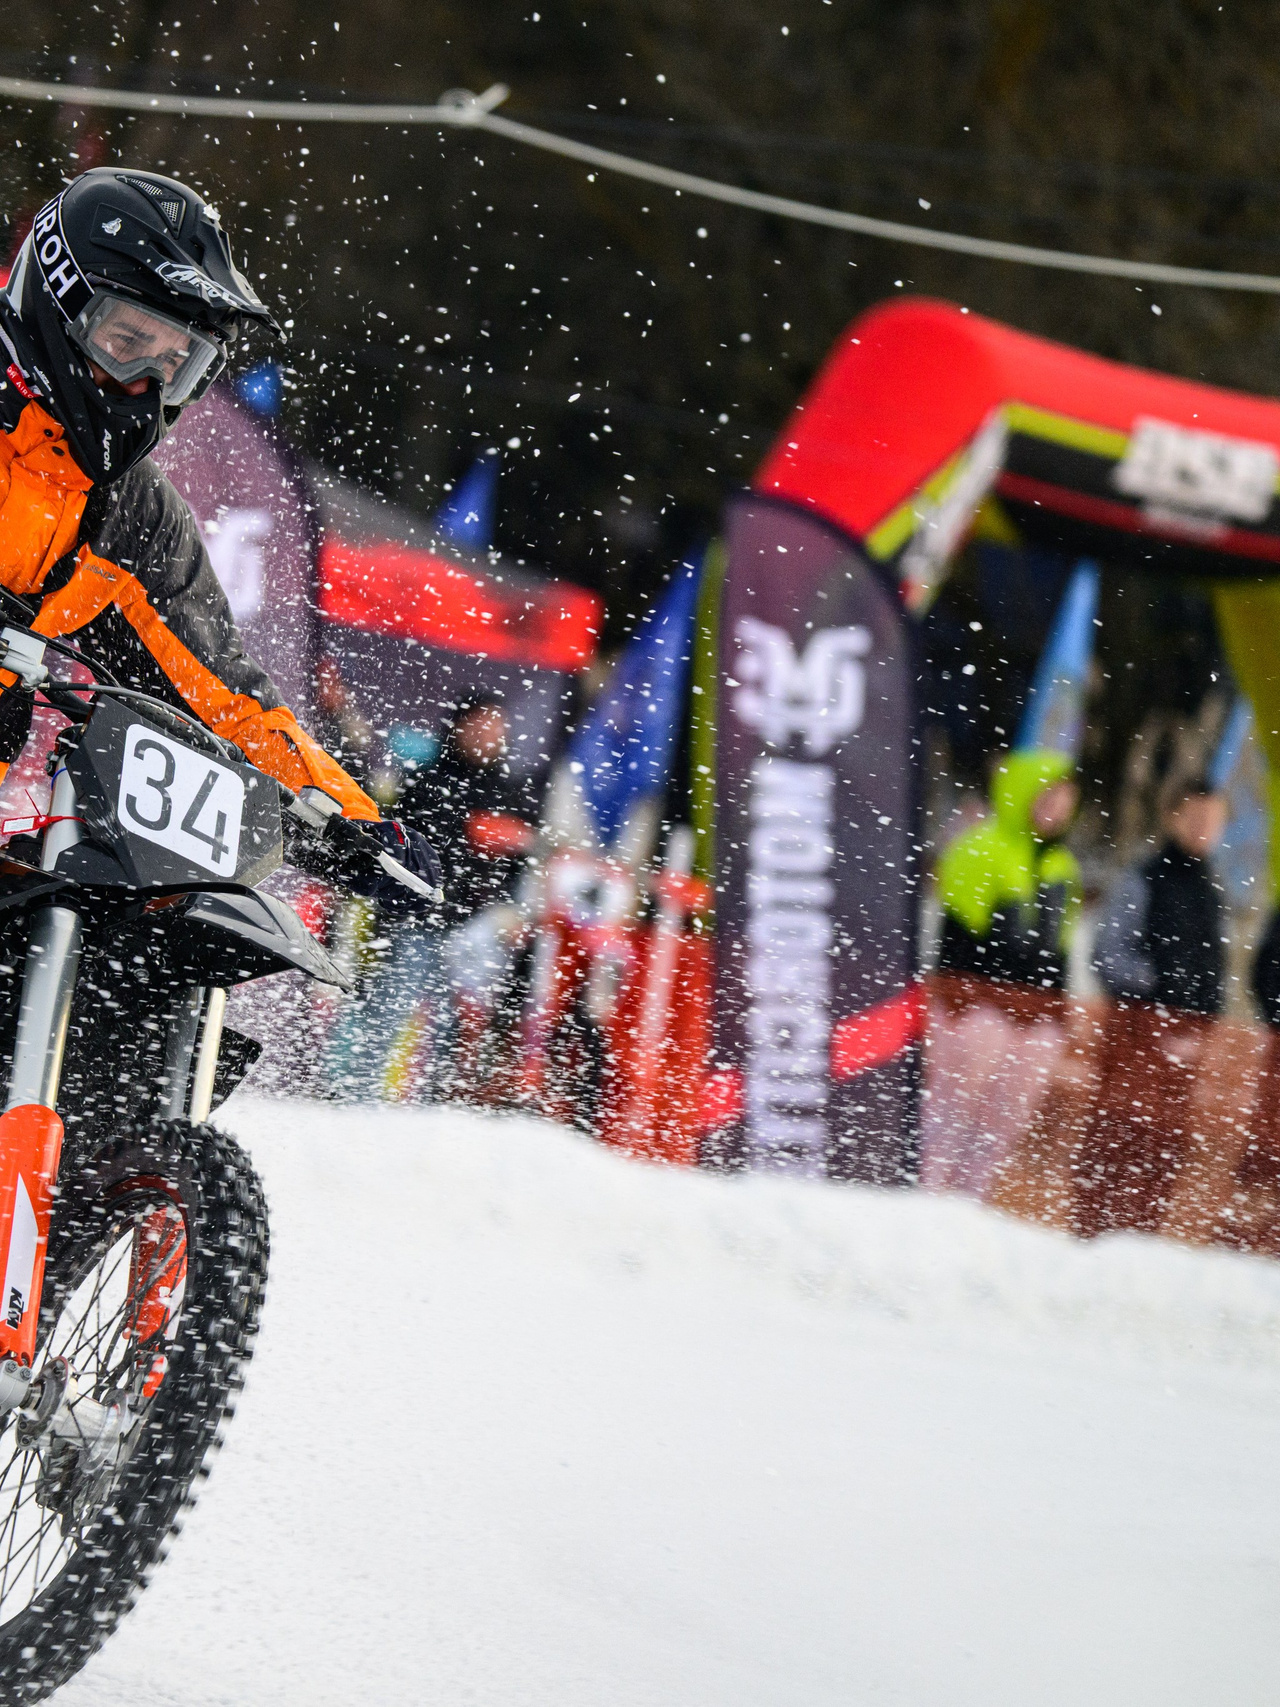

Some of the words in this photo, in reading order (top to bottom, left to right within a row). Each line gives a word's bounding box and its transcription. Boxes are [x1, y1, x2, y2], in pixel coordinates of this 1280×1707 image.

[36, 200, 79, 298] IROH
[102, 428, 112, 471] Airoh
[125, 738, 229, 864] 34
[6, 1286, 24, 1330] KTM
